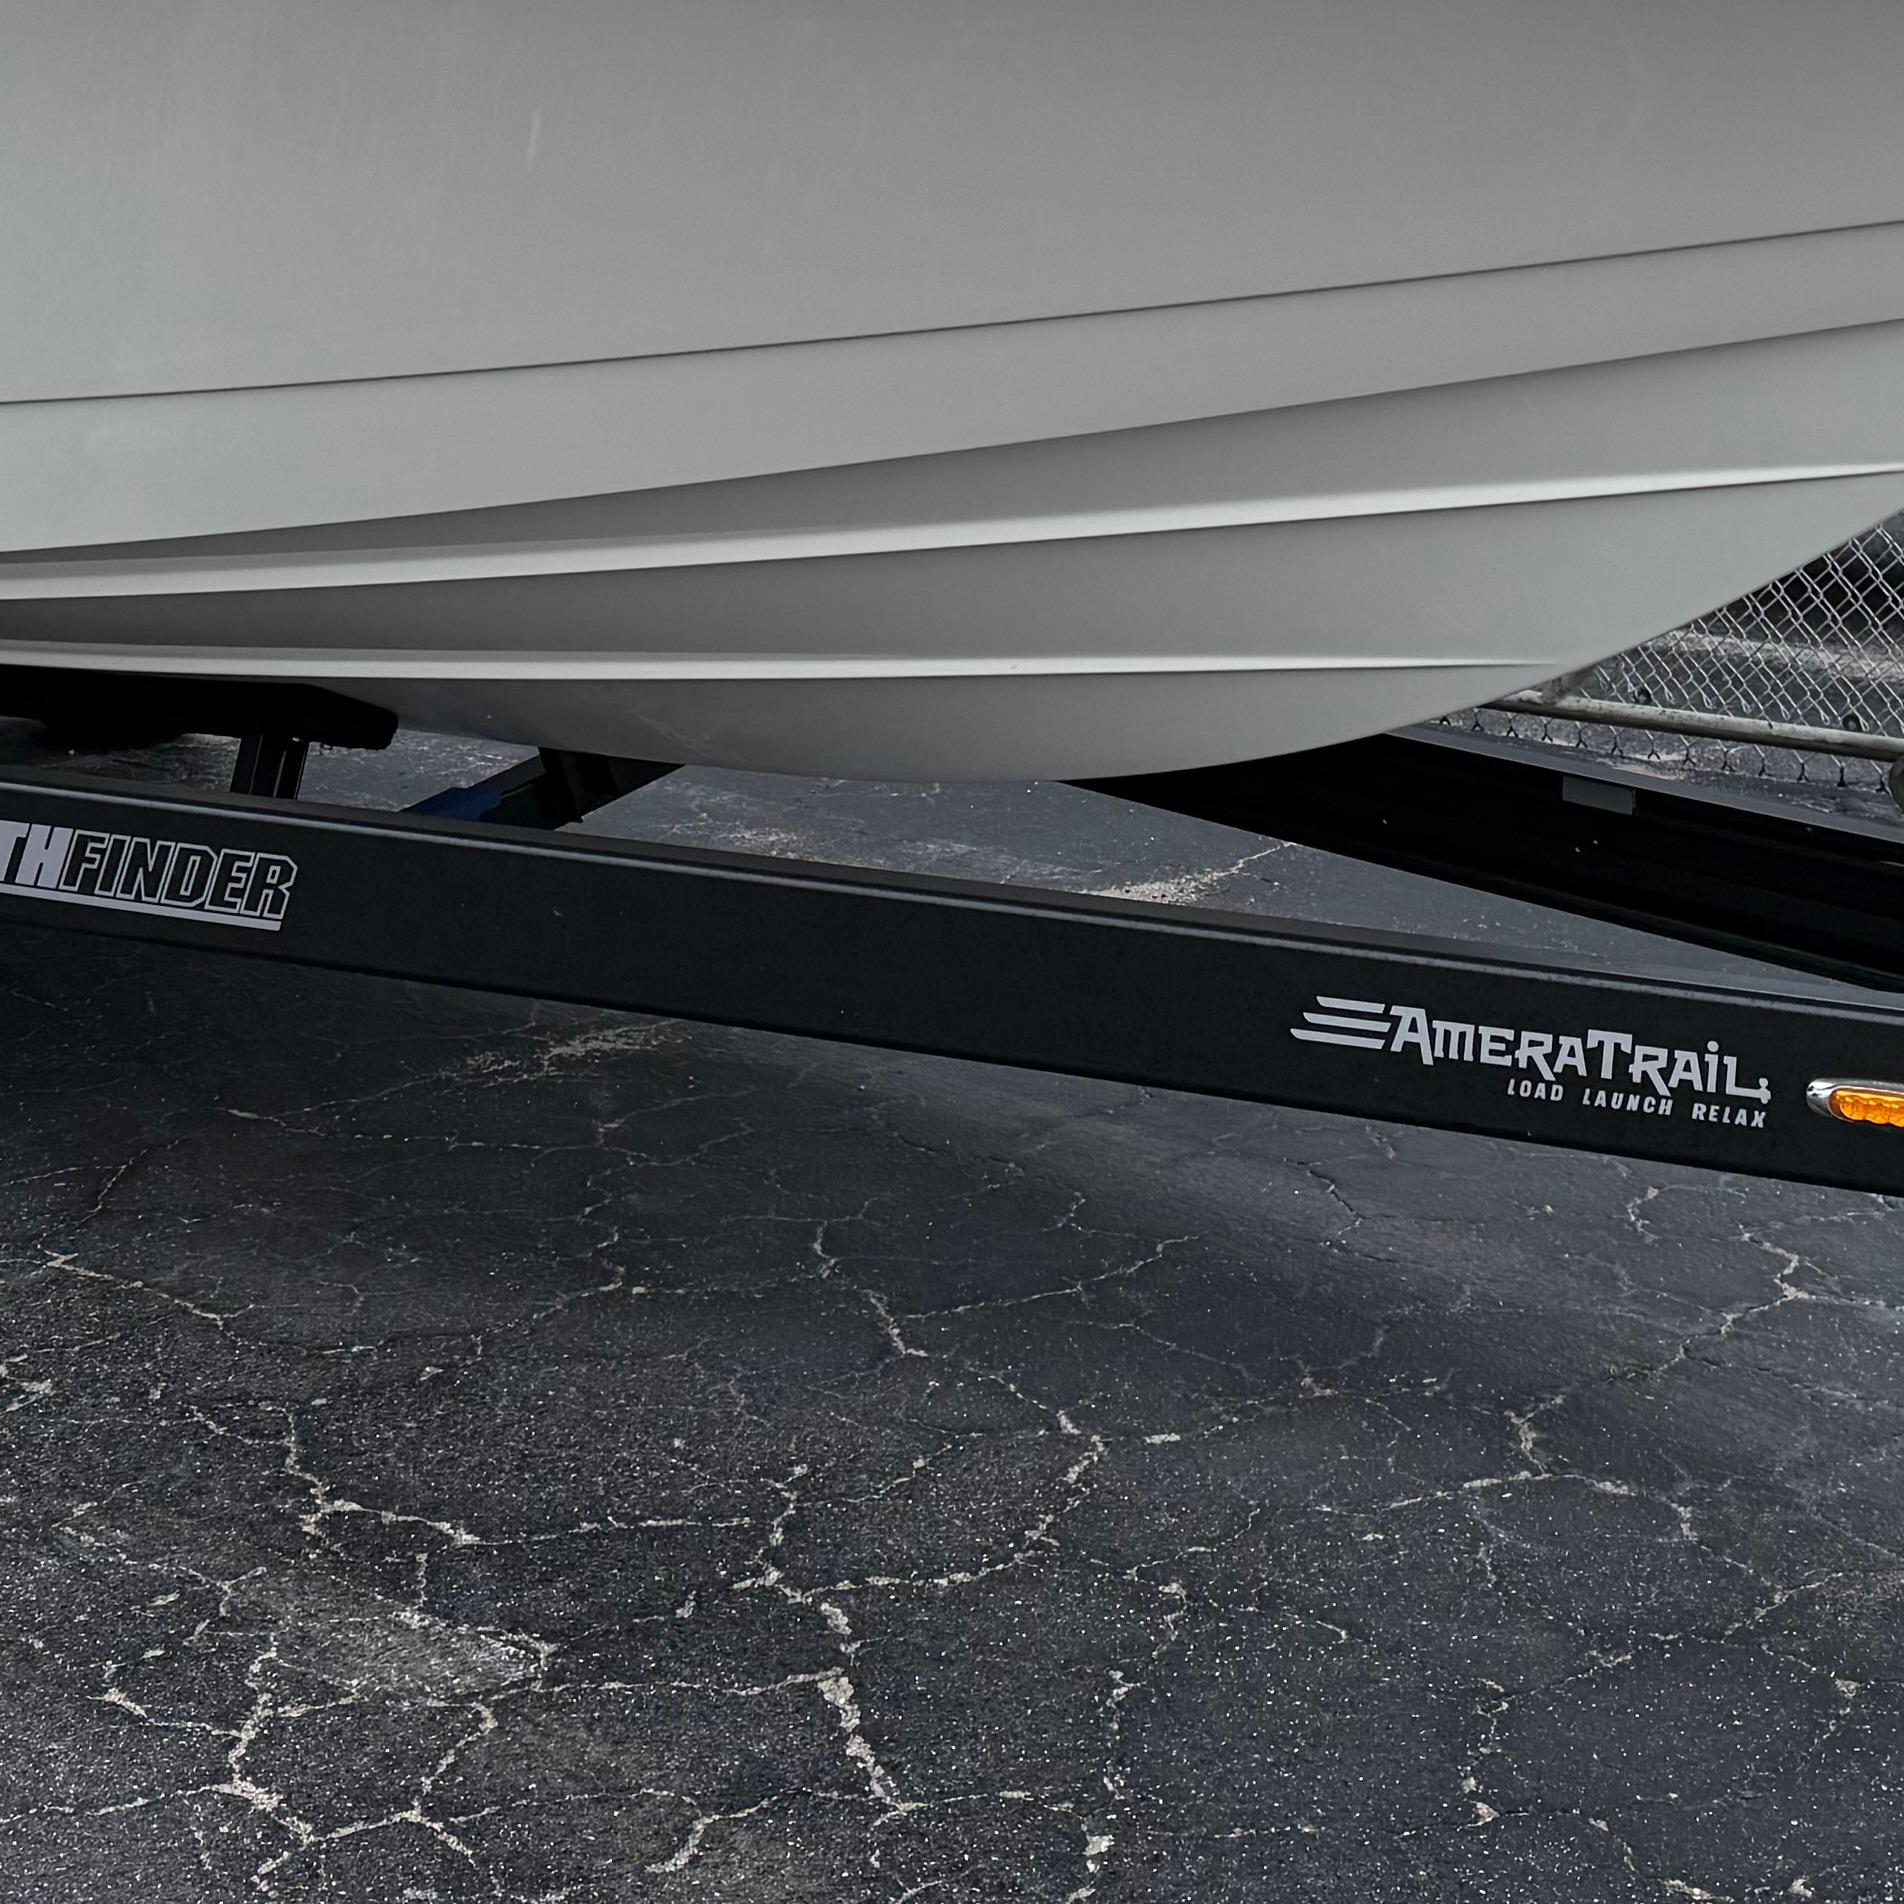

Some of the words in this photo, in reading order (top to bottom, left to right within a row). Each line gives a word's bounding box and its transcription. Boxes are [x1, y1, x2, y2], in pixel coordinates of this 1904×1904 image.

[1506, 1077, 1564, 1102] LOAD
[1582, 1088, 1673, 1116] LAUNCH
[1691, 1102, 1769, 1129] RELAX
